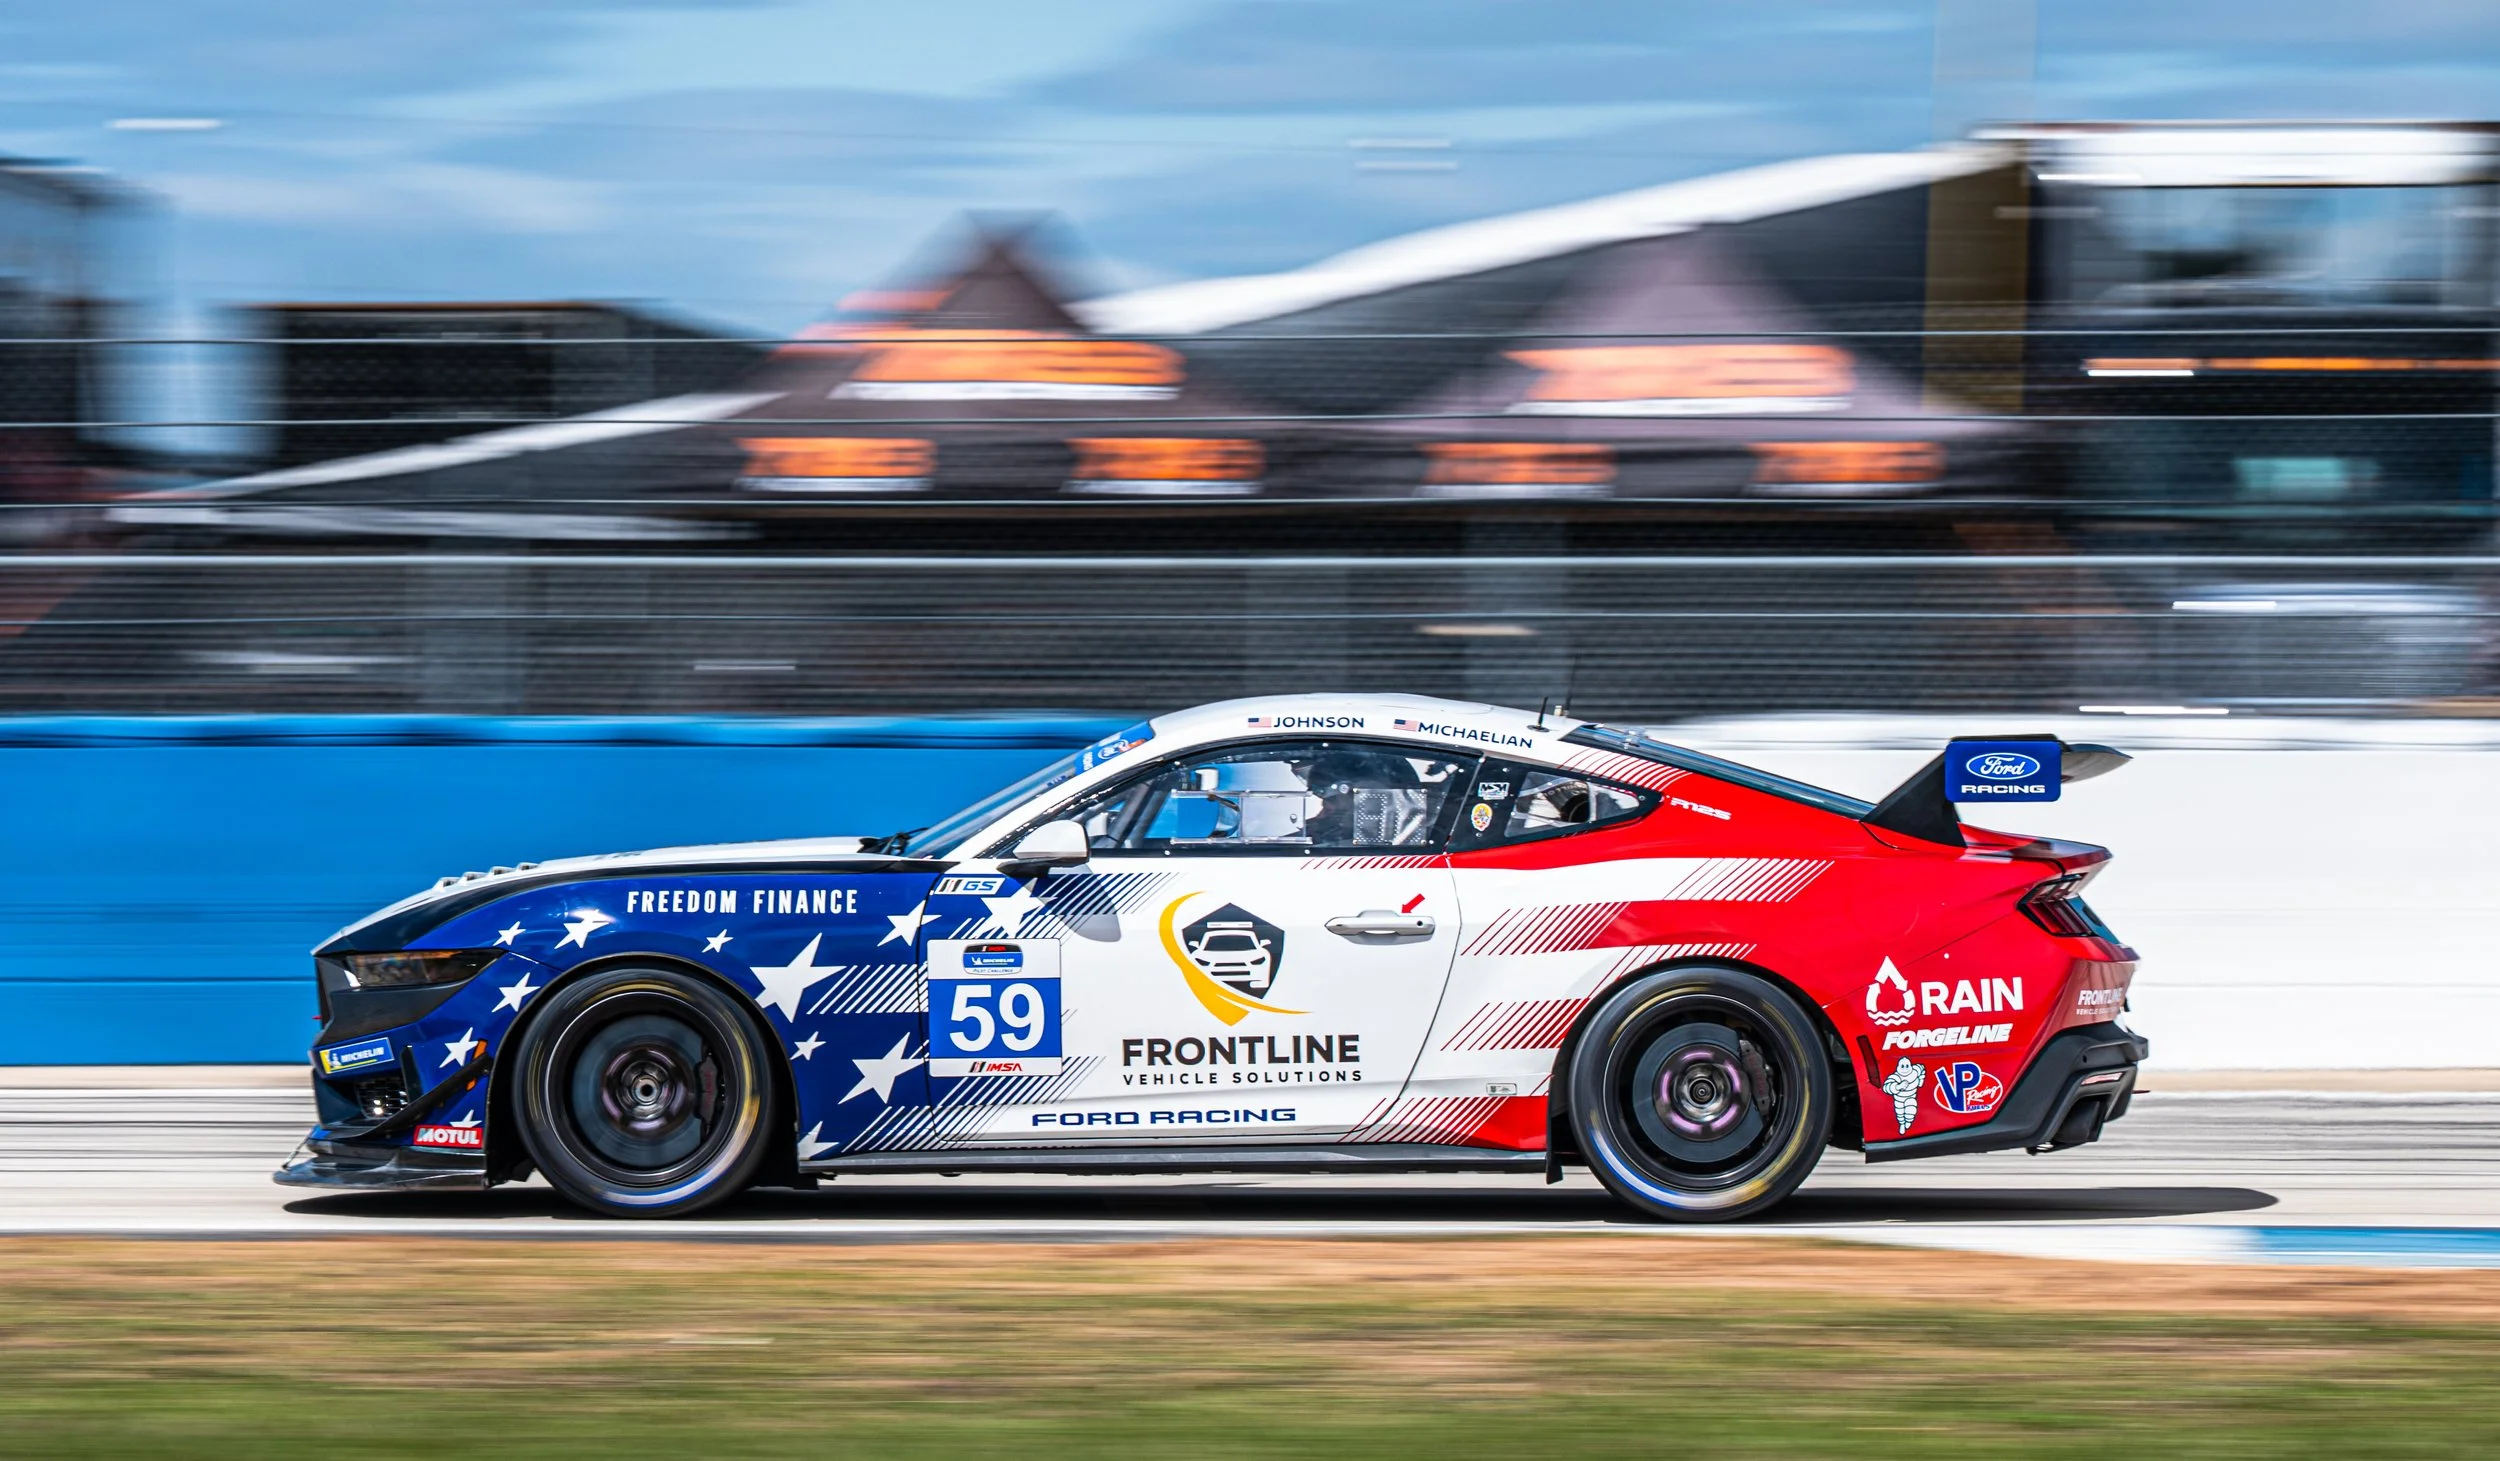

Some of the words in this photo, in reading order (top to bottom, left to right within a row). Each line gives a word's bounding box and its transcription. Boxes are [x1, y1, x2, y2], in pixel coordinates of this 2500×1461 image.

[1273, 717, 1364, 728] JOHNSON
[1418, 722, 1533, 749] MICHAELIAN
[1980, 755, 2026, 775] Ford
[1961, 784, 2046, 794] RACING
[962, 880, 998, 891] GS
[627, 890, 737, 913] FREEDOM
[753, 889, 858, 914] FINANCE
[1920, 976, 2024, 1016] RAIN
[949, 982, 1045, 1052] 59
[1882, 1023, 2014, 1050] FORGELINE
[340, 1046, 385, 1063] MICHELIN
[1122, 1034, 1360, 1067] FRONTLINE
[986, 1063, 1023, 1072] IMSA
[1123, 1072, 1218, 1086] VEHICLE
[1232, 1070, 1362, 1084] SOLUTIONS
[1934, 1061, 1982, 1112] VP
[1966, 1086, 2001, 1105] Racing
[1032, 1111, 1140, 1126] FORD
[1150, 1108, 1296, 1124] RACING
[417, 1127, 480, 1144] MOTUL
